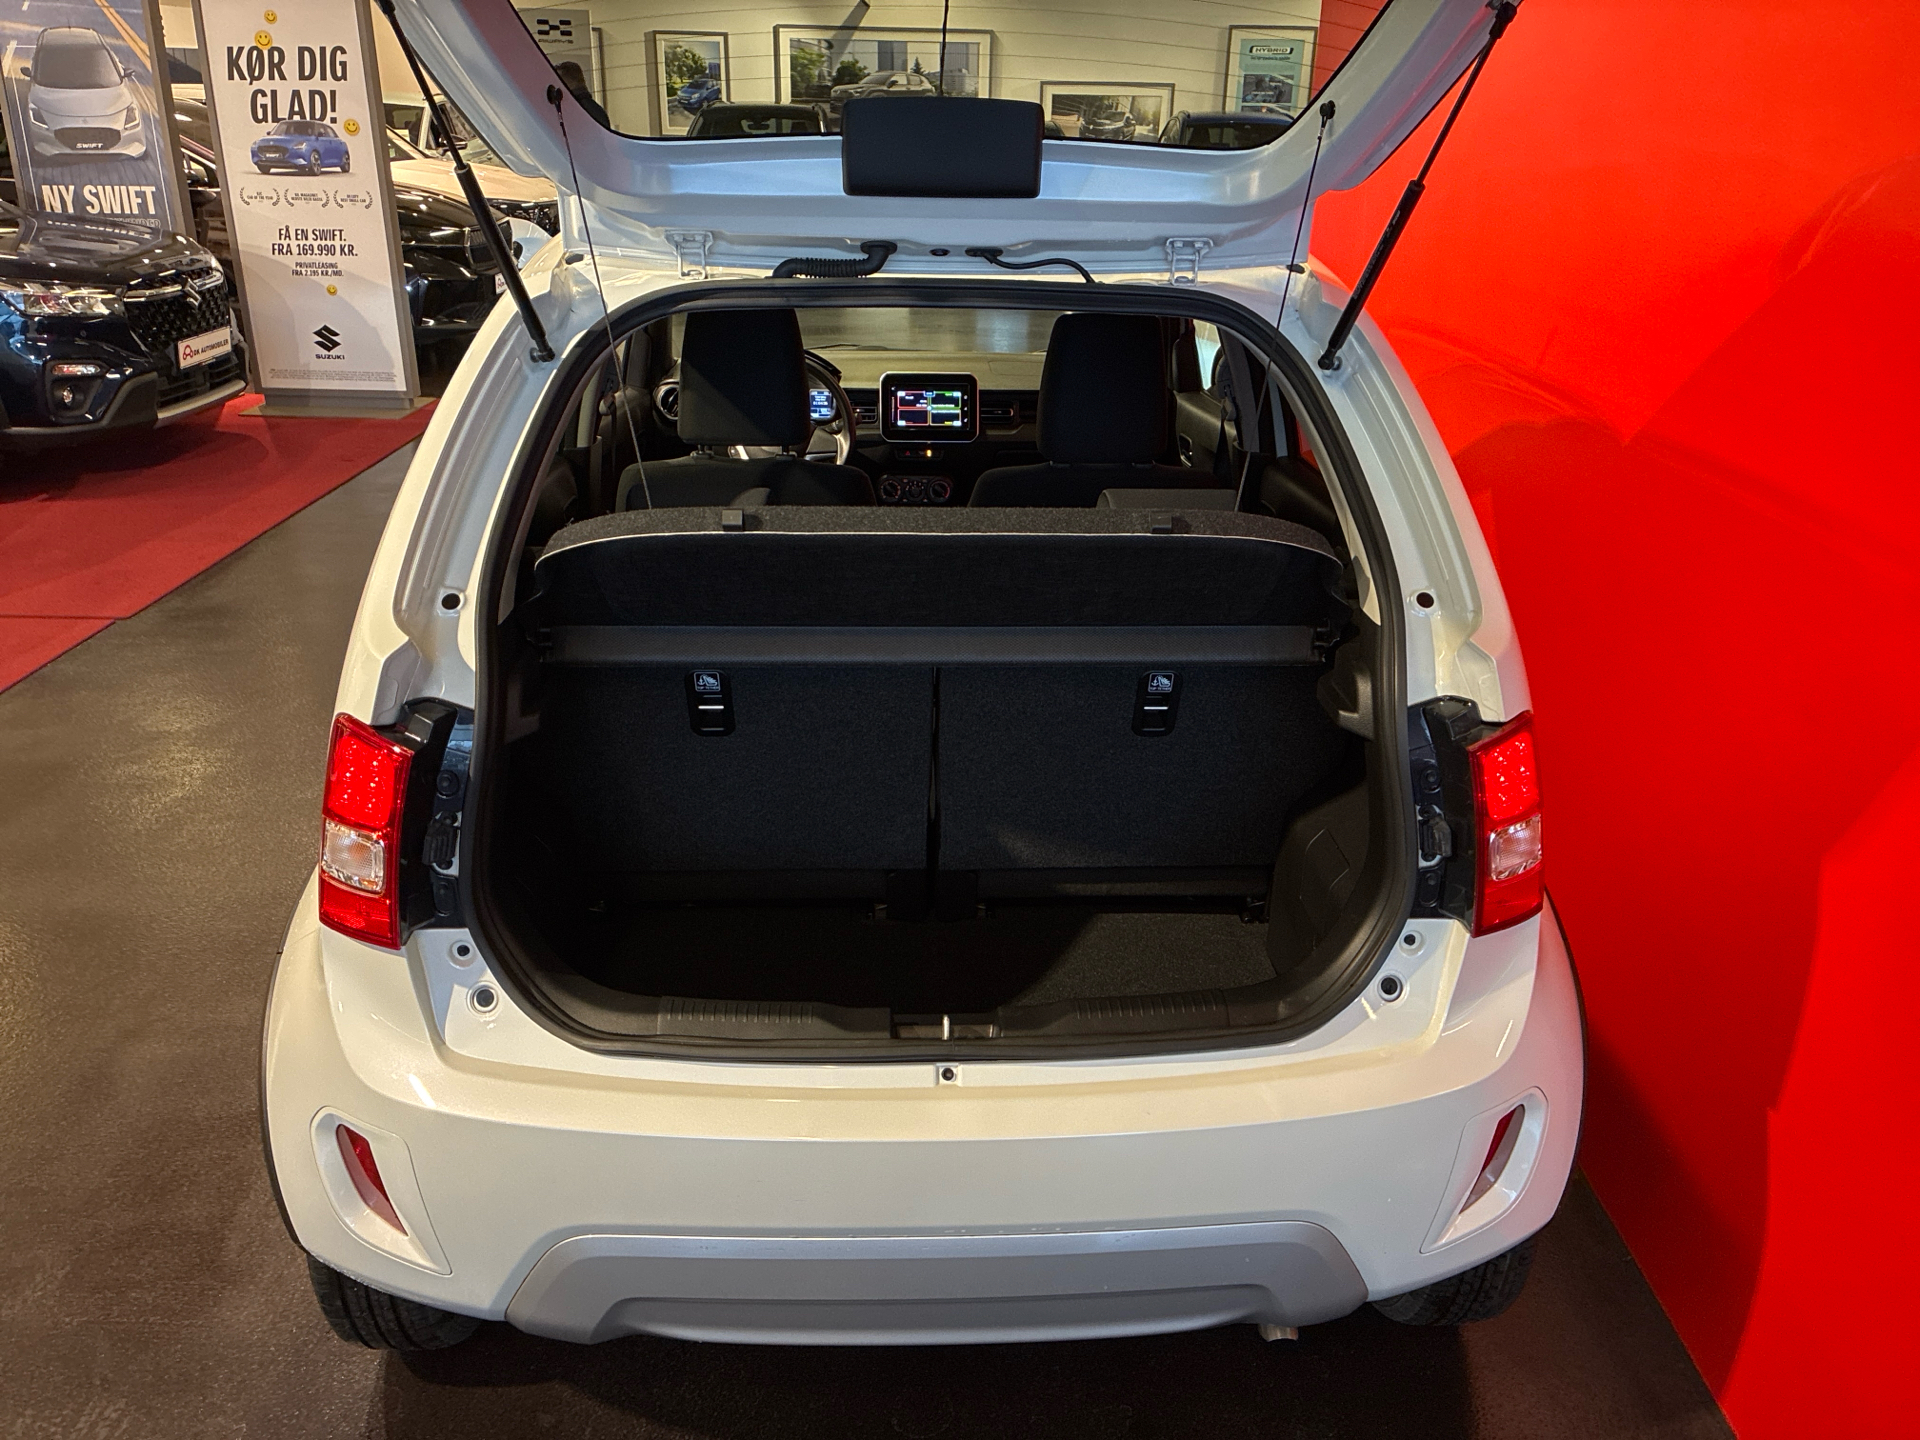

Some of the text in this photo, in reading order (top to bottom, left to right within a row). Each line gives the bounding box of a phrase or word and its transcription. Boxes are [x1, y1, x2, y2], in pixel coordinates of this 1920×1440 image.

[226, 45, 348, 85] KØR DIG
[250, 88, 337, 124] GLAD!
[41, 184, 156, 215] NY SWIFT
[278, 225, 347, 241] FÅ EN SWIFT.
[272, 243, 358, 256] FRA 169.990 KR.
[201, 339, 229, 353] AUTOMOBILER
